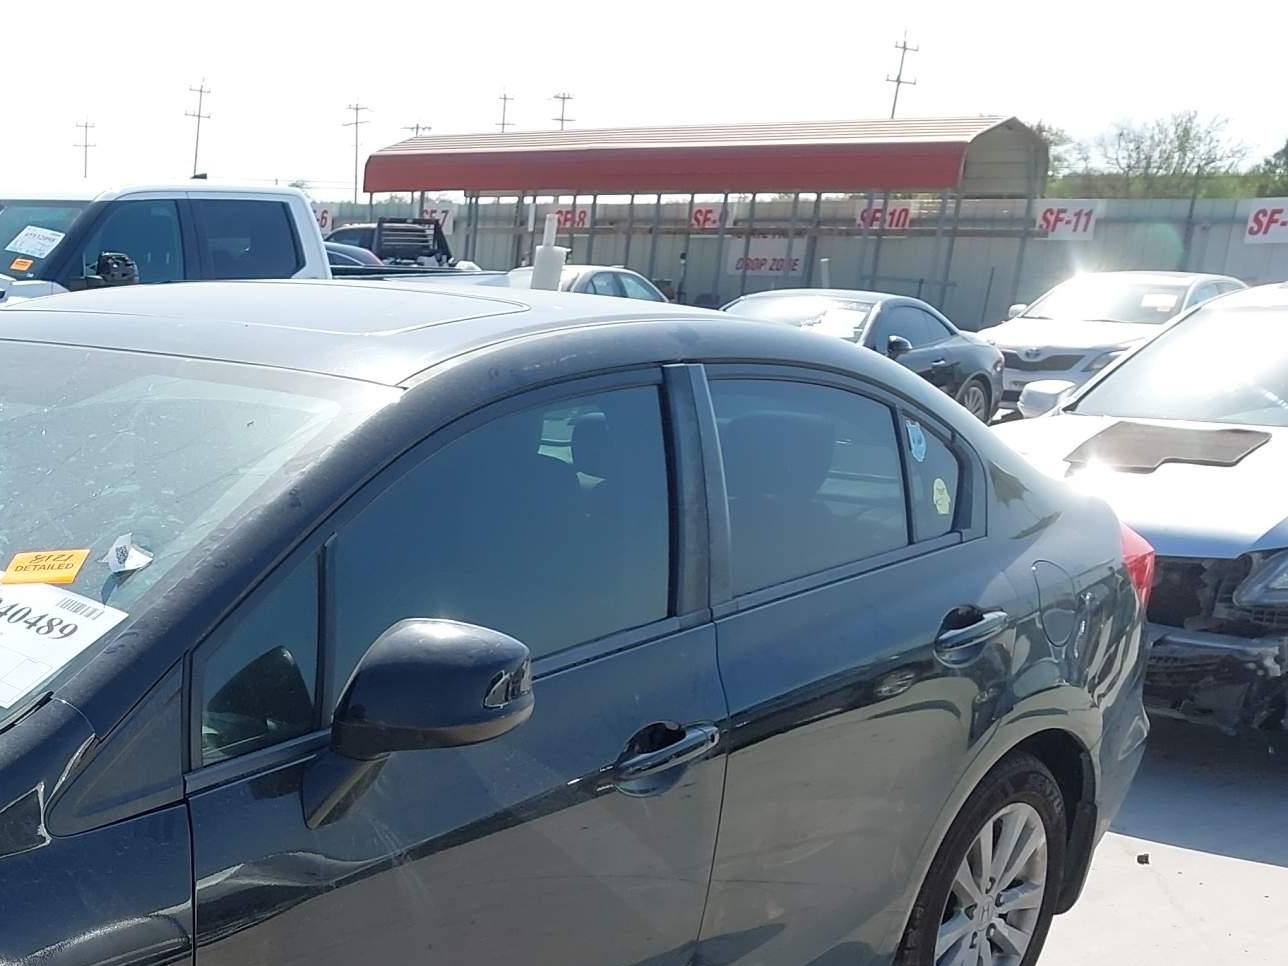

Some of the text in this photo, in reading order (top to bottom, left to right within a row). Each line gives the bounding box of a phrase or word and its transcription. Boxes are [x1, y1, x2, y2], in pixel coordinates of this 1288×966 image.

[555, 209, 587, 227] SF8
[857, 207, 910, 229] SF10
[1038, 207, 1094, 234] SF-11
[14, 563, 74, 573] DETAILED
